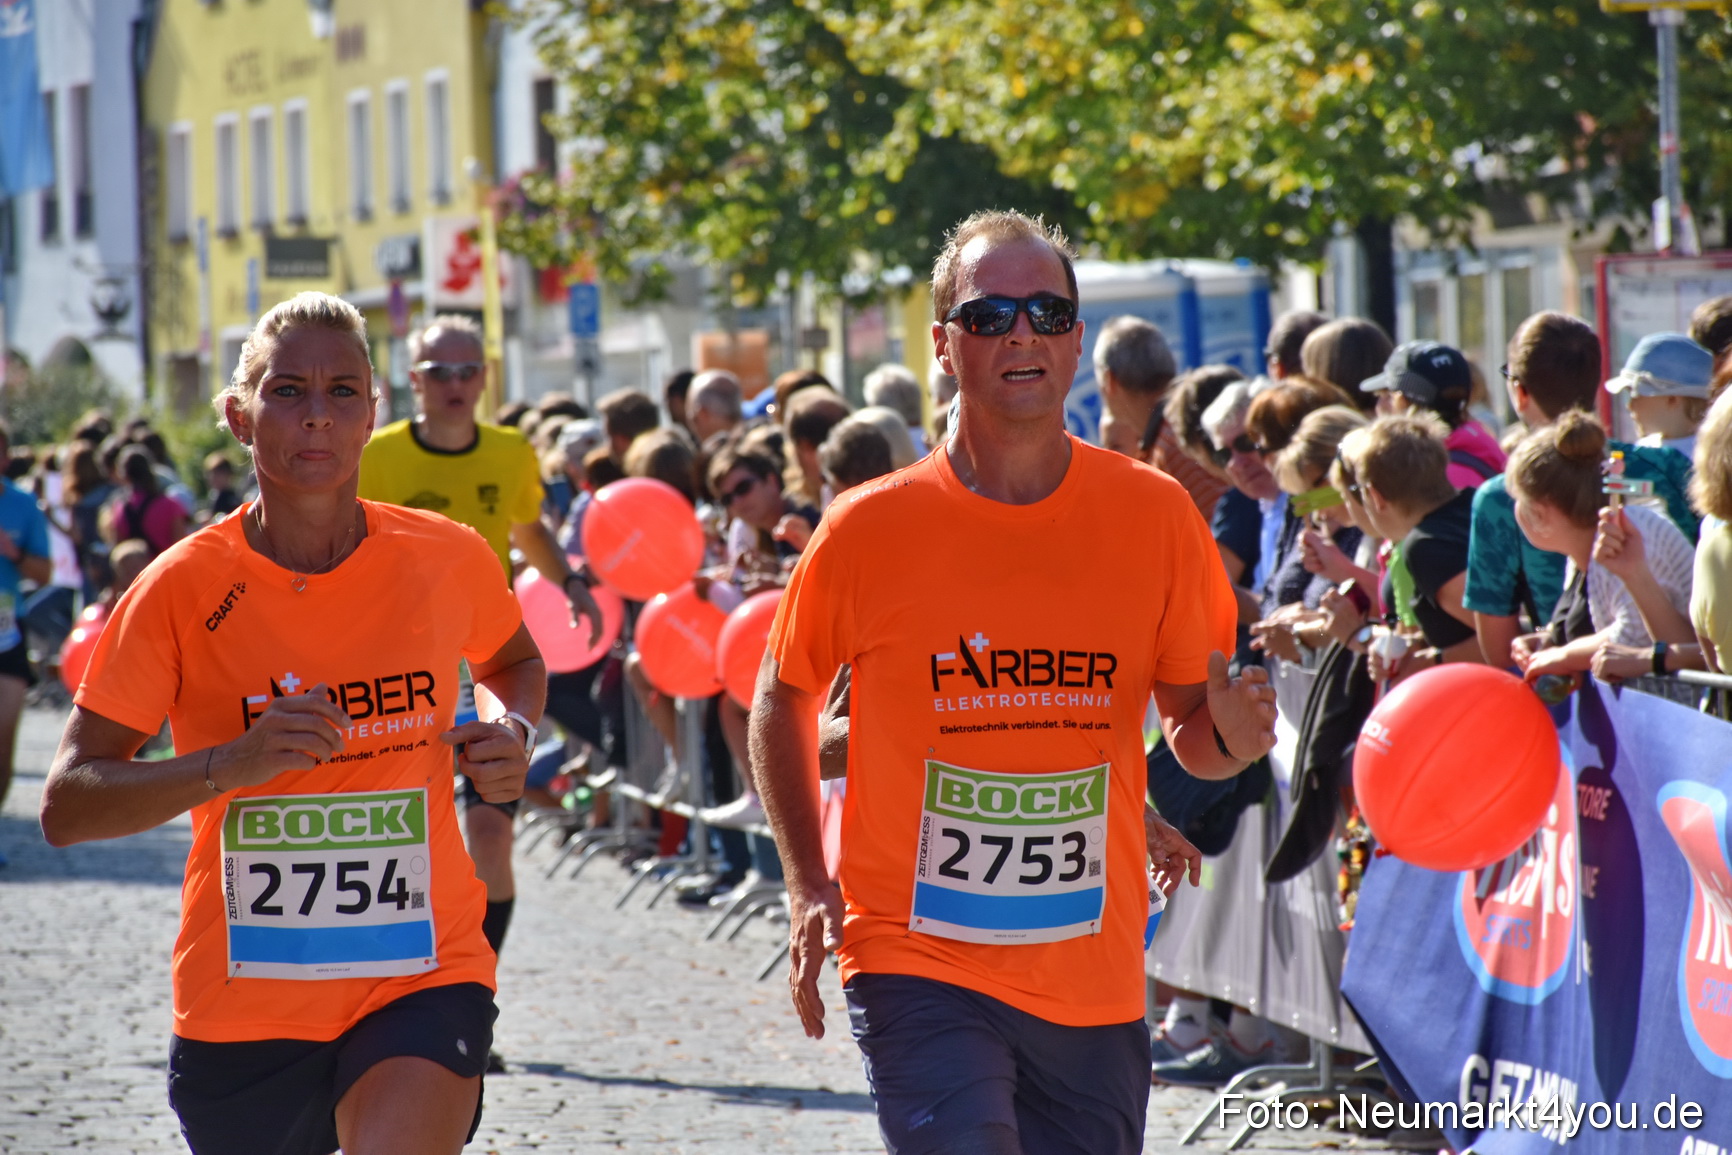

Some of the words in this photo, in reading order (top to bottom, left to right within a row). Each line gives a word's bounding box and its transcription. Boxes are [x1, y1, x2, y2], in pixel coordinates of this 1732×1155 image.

[205, 589, 239, 632] CRAFT
[934, 692, 1112, 712] ELEKTROTECHNIK
[940, 722, 1009, 735] Elektrotechnik
[1011, 719, 1060, 731] verbindet.
[1063, 719, 1078, 729] Sie
[325, 750, 376, 765] erbindet.
[392, 742, 413, 753] und
[938, 775, 1093, 817] BOCK
[240, 803, 409, 842] BOCK
[938, 828, 1087, 885] 2753
[249, 858, 410, 917] 2754
